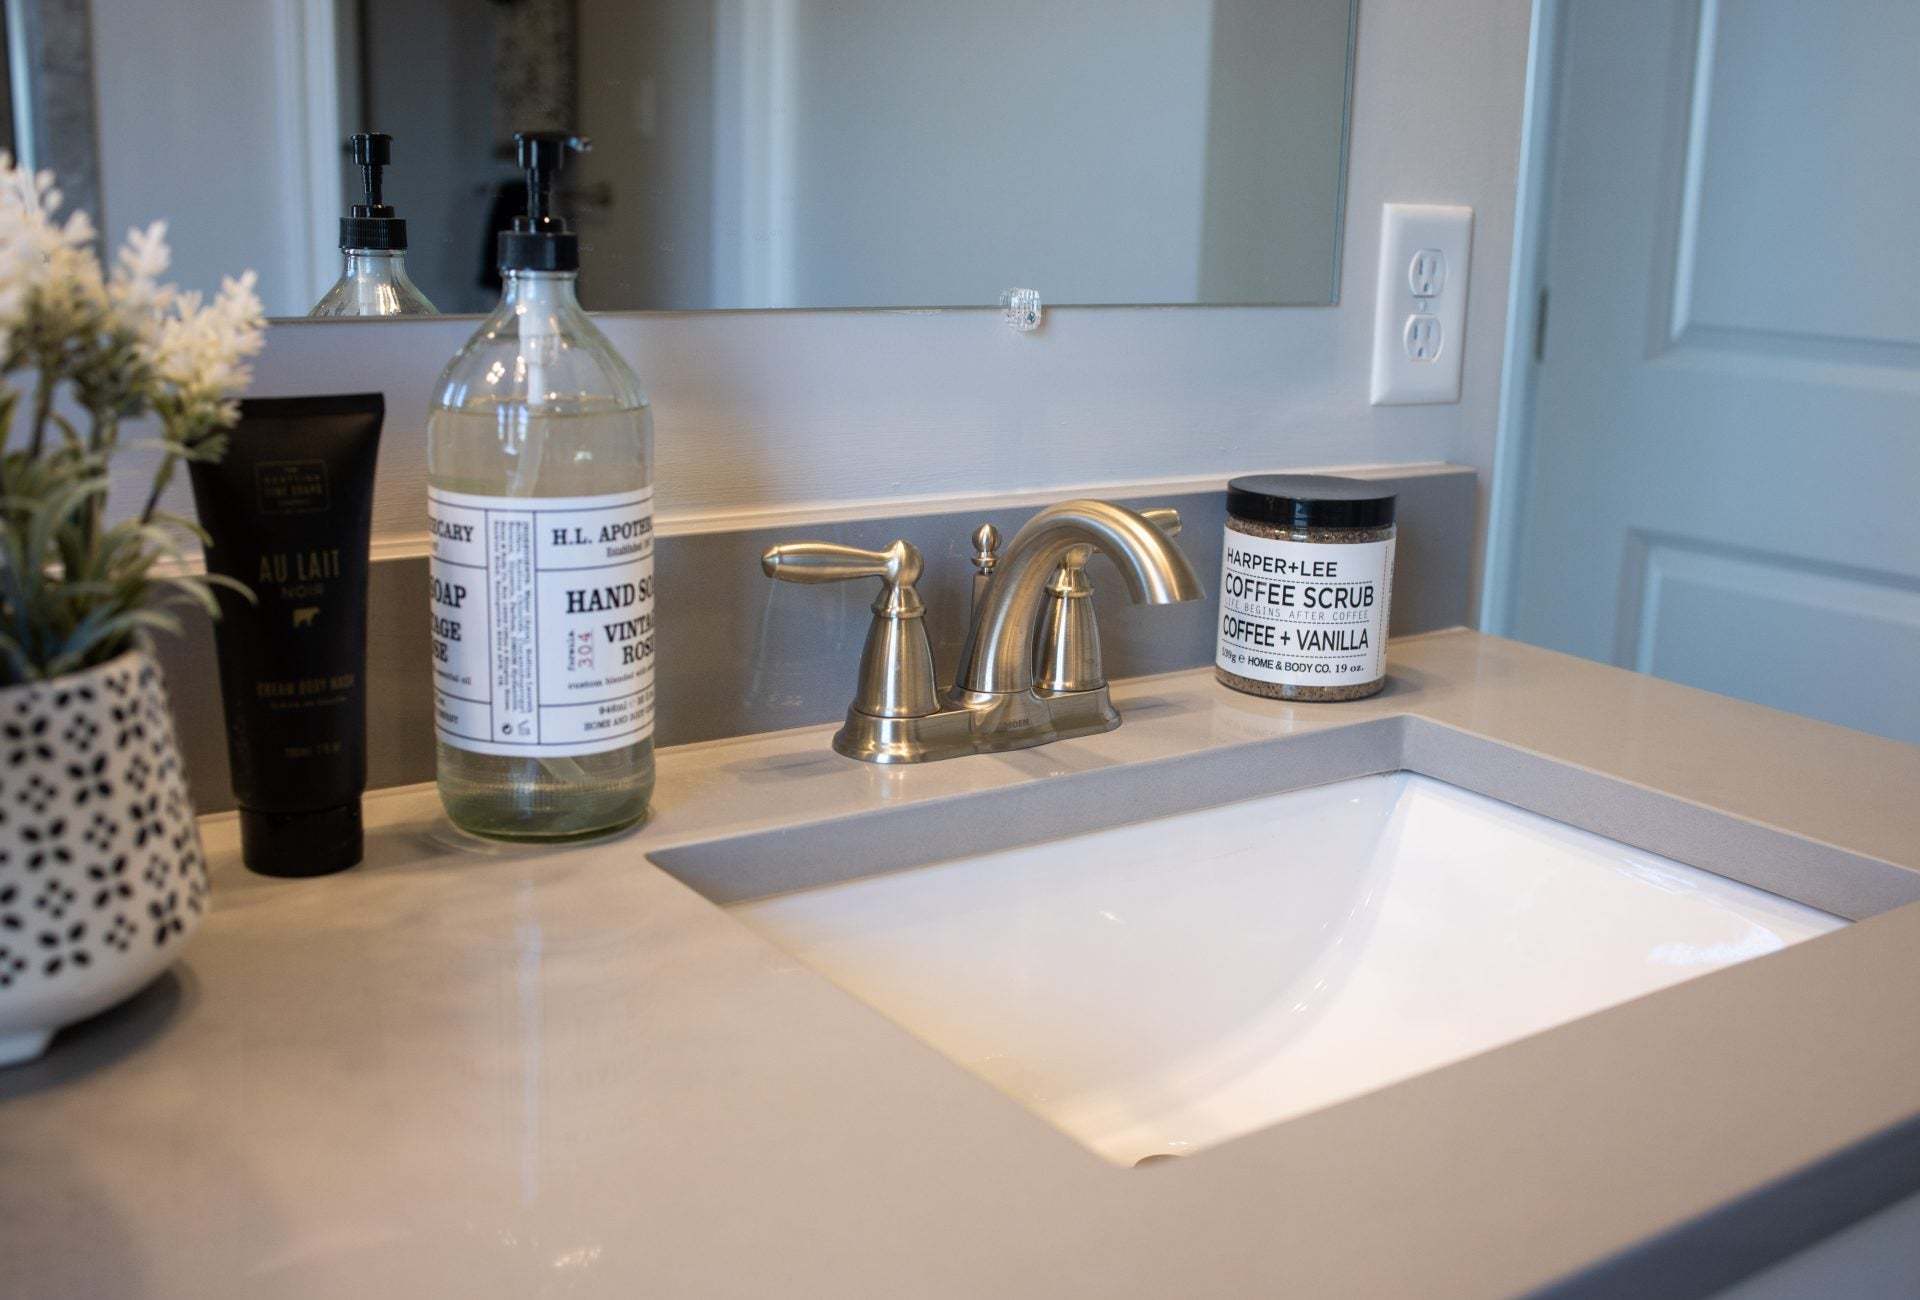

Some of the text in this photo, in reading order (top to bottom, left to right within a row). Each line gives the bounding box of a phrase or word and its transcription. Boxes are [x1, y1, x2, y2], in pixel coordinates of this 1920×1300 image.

[552, 527, 592, 546] H.L.
[259, 548, 341, 583] AU LAIT
[1227, 546, 1338, 578] HARPER+LEE
[566, 583, 635, 614] HAND
[1225, 573, 1374, 609] COFFEE SCRUB
[1244, 601, 1281, 618] BEGINS
[1289, 607, 1325, 621] AFTER
[1332, 609, 1369, 622] COFFEE
[1223, 614, 1370, 652] COFFEE + VANILLA
[577, 631, 593, 669] 304
[1247, 655, 1274, 670] HOME
[1275, 661, 1283, 671] &
[1284, 662, 1314, 673] BODY
[1315, 664, 1331, 674] CO.
[1335, 664, 1347, 674] 19
[1350, 665, 1364, 673] oz.
